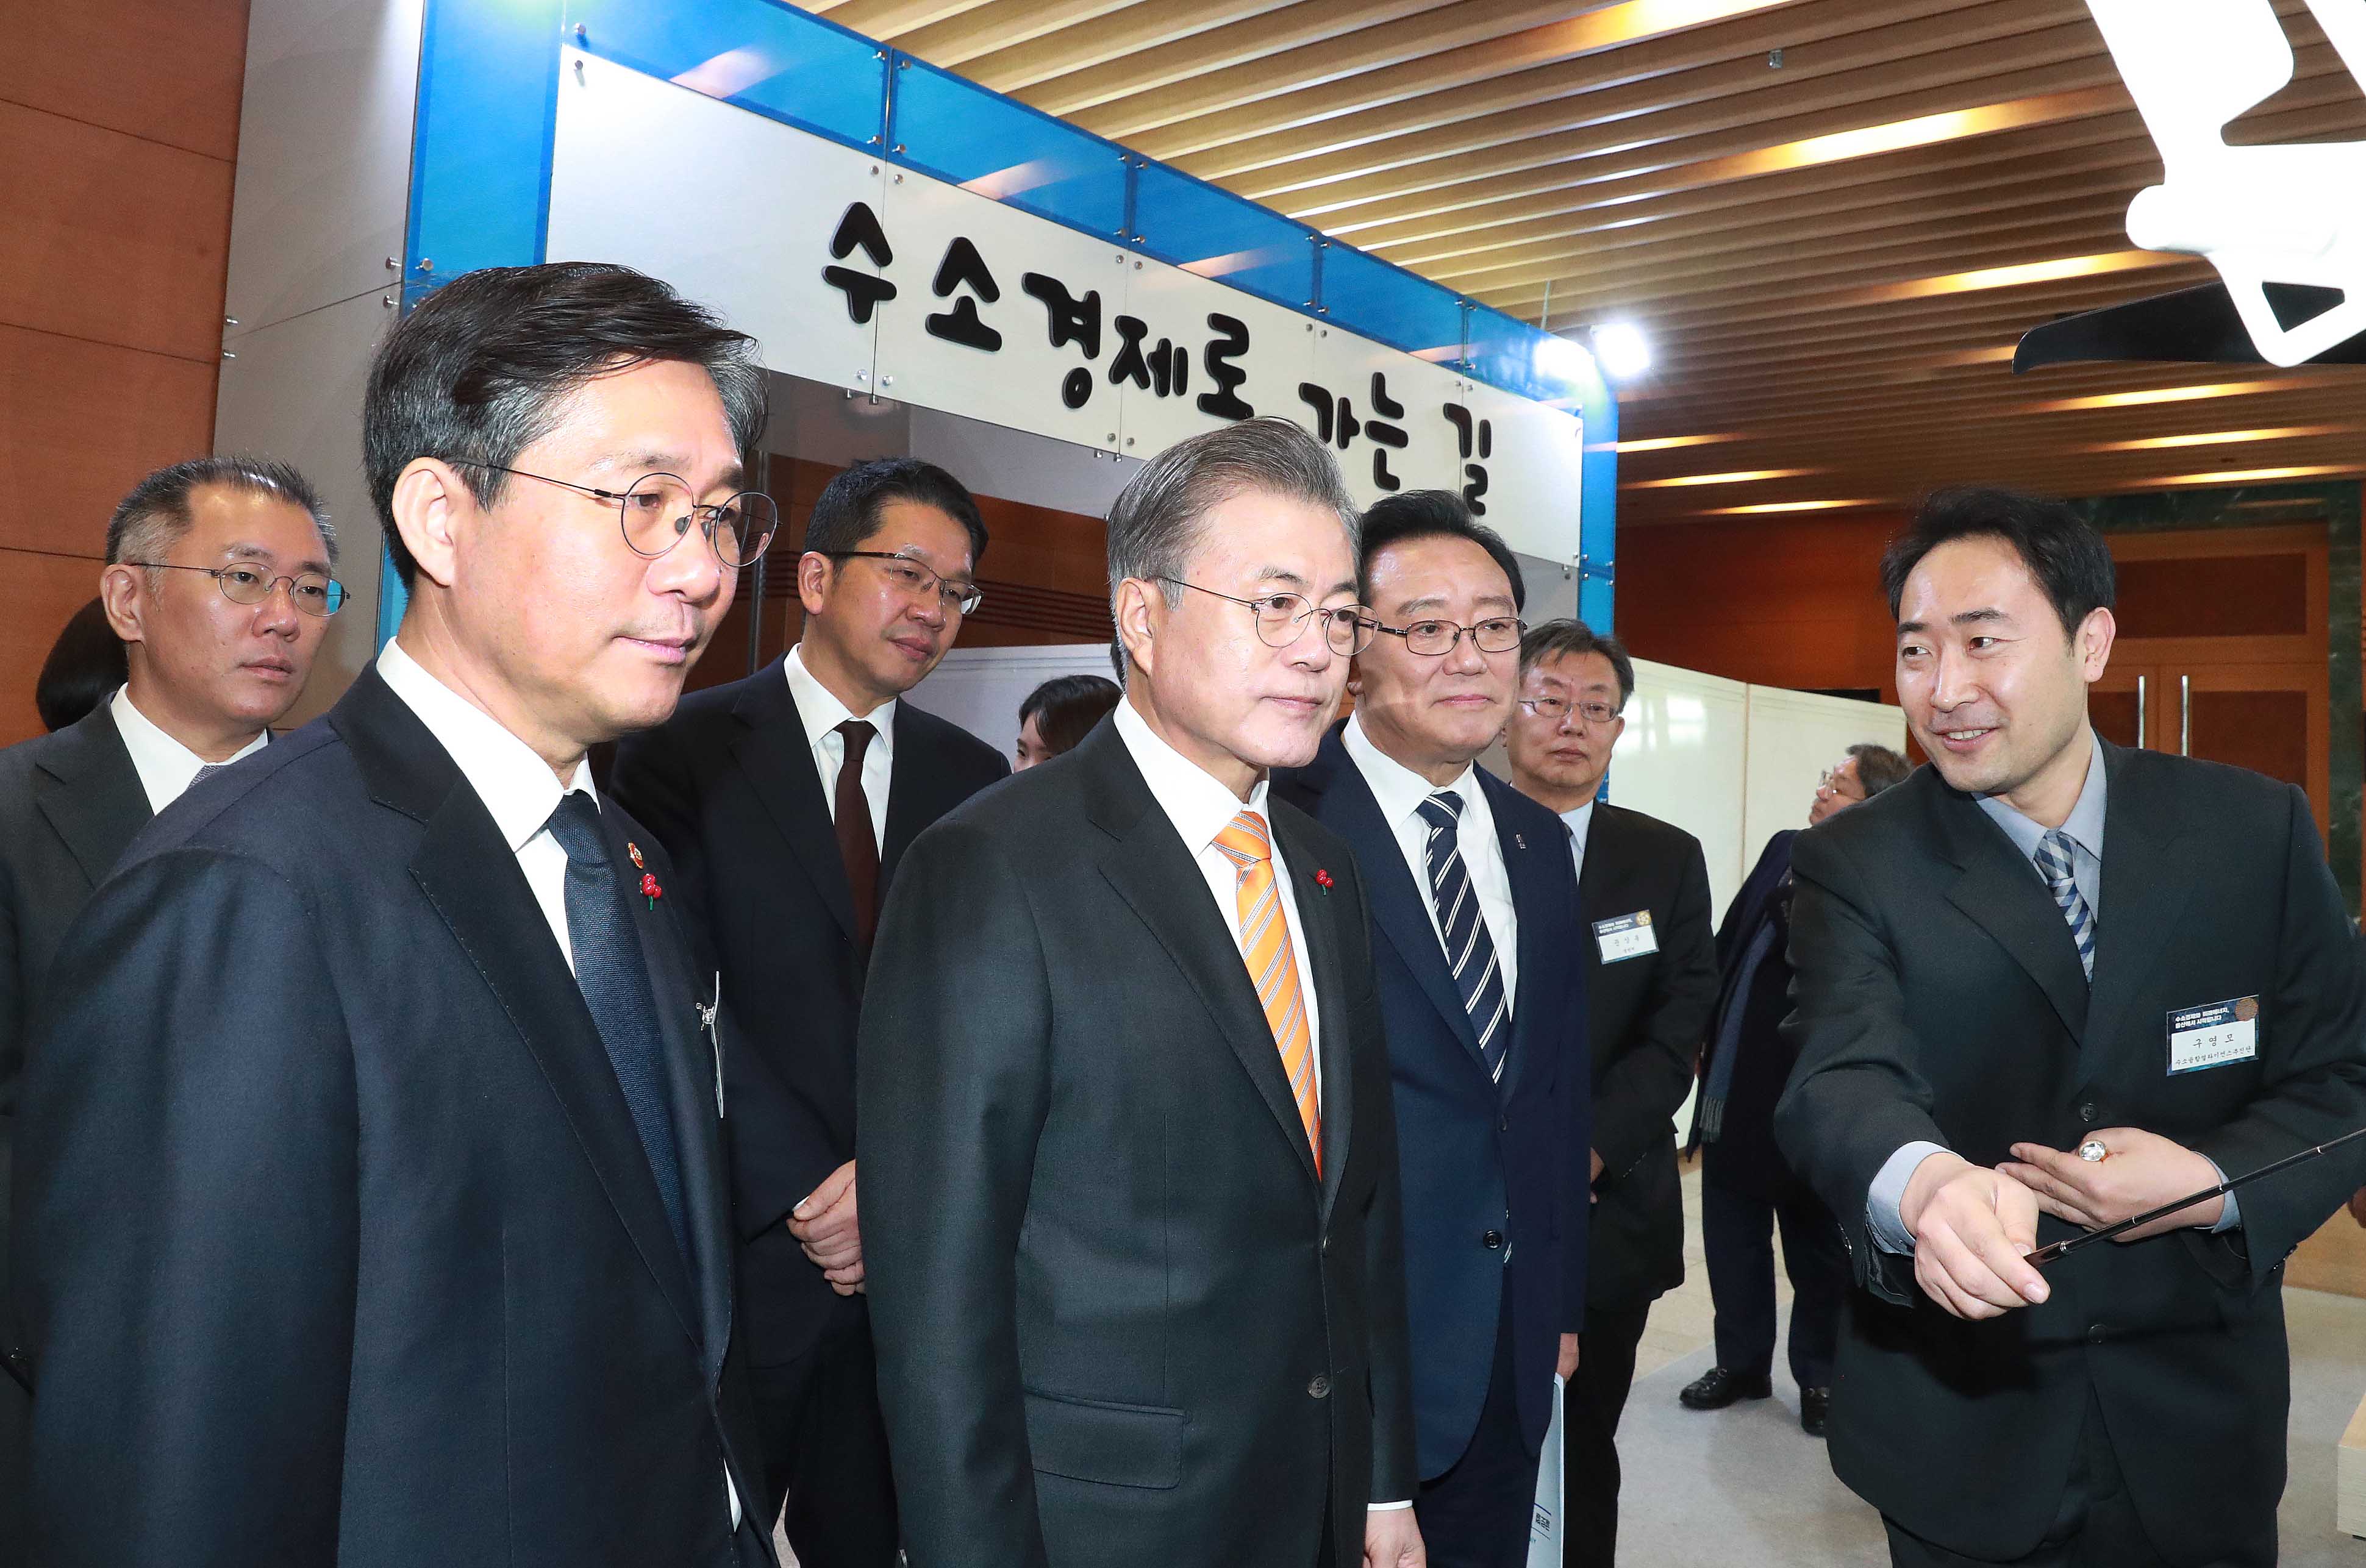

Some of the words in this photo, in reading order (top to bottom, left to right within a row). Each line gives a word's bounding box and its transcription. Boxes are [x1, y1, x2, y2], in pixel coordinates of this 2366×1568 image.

[821, 202, 1254, 421] 수소경제로
[1299, 371, 1409, 490] 가는
[1443, 402, 1492, 516] 길
